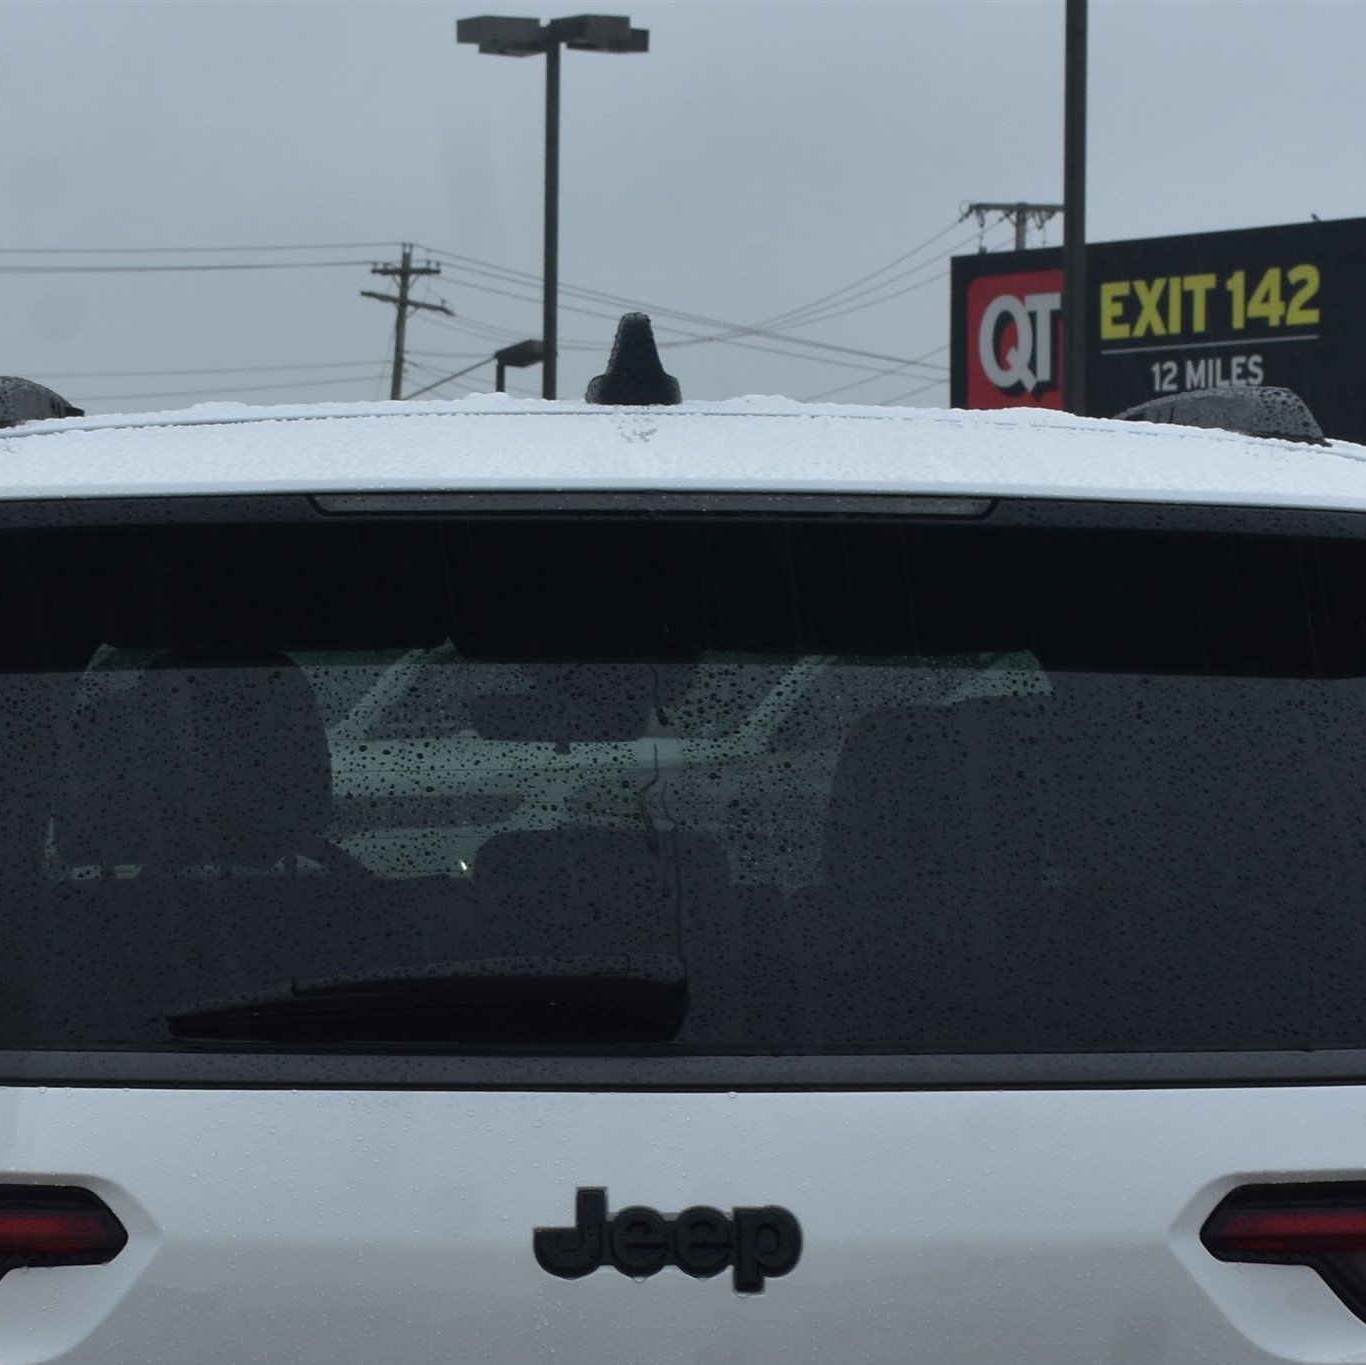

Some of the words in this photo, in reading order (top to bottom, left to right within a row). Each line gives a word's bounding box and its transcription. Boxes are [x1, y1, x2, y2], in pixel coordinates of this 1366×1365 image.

[978, 292, 1062, 393] QT
[1100, 273, 1217, 340] EXIT
[1225, 263, 1322, 330] 142
[1151, 361, 1179, 392] 12
[1184, 355, 1265, 390] MILES
[532, 1186, 803, 1294] Jeep
